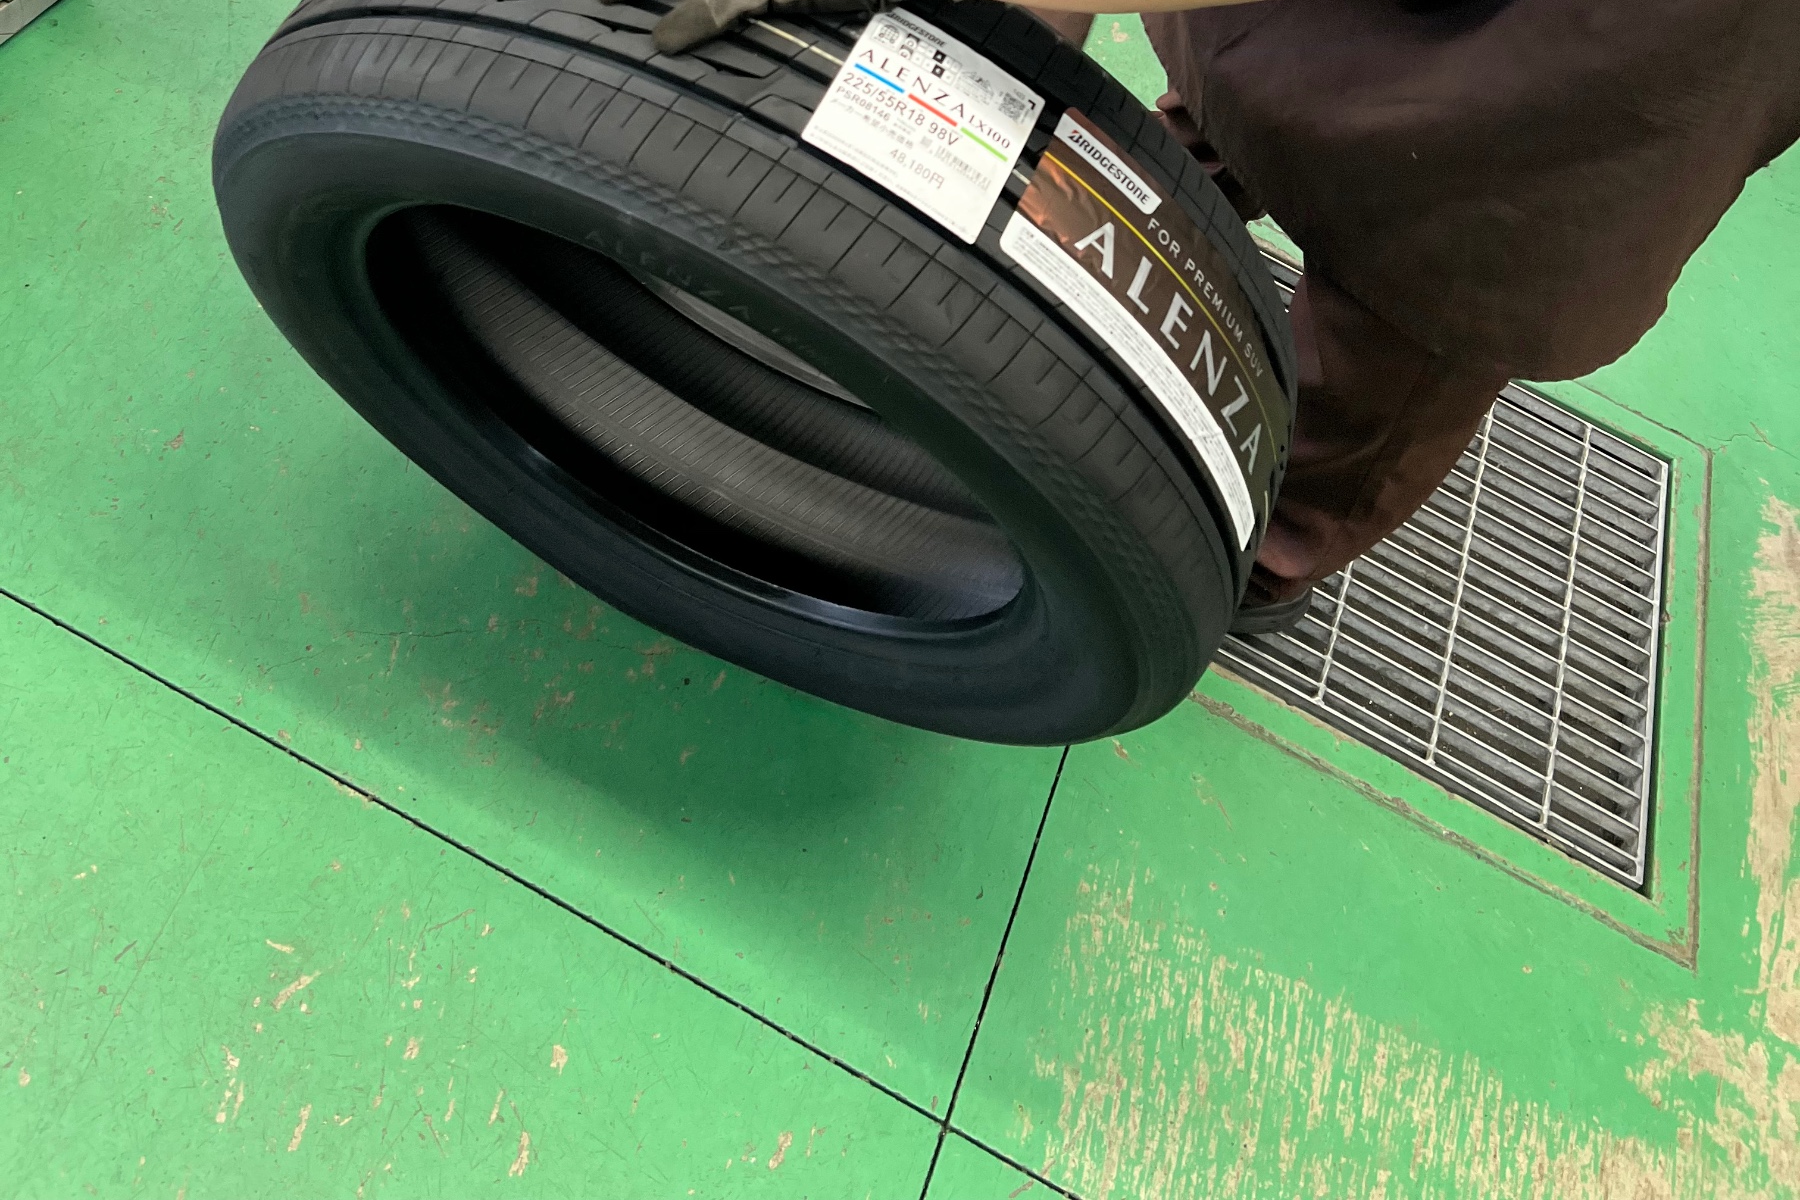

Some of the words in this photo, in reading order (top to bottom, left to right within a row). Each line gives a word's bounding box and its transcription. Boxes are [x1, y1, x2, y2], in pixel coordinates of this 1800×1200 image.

[836, 85, 891, 123] PSR08146
[842, 71, 926, 127] 225/55R18
[927, 120, 960, 147] 98V
[859, 48, 966, 120] ALENZA
[967, 113, 1012, 150] LX100
[889, 147, 946, 190] 48,180円
[1067, 128, 1152, 206] BRIDGESTONE
[1147, 217, 1181, 256] FOR
[1184, 257, 1245, 344] PREMIUM
[1243, 340, 1265, 378] SUV
[1073, 220, 1263, 476] ALENZA
